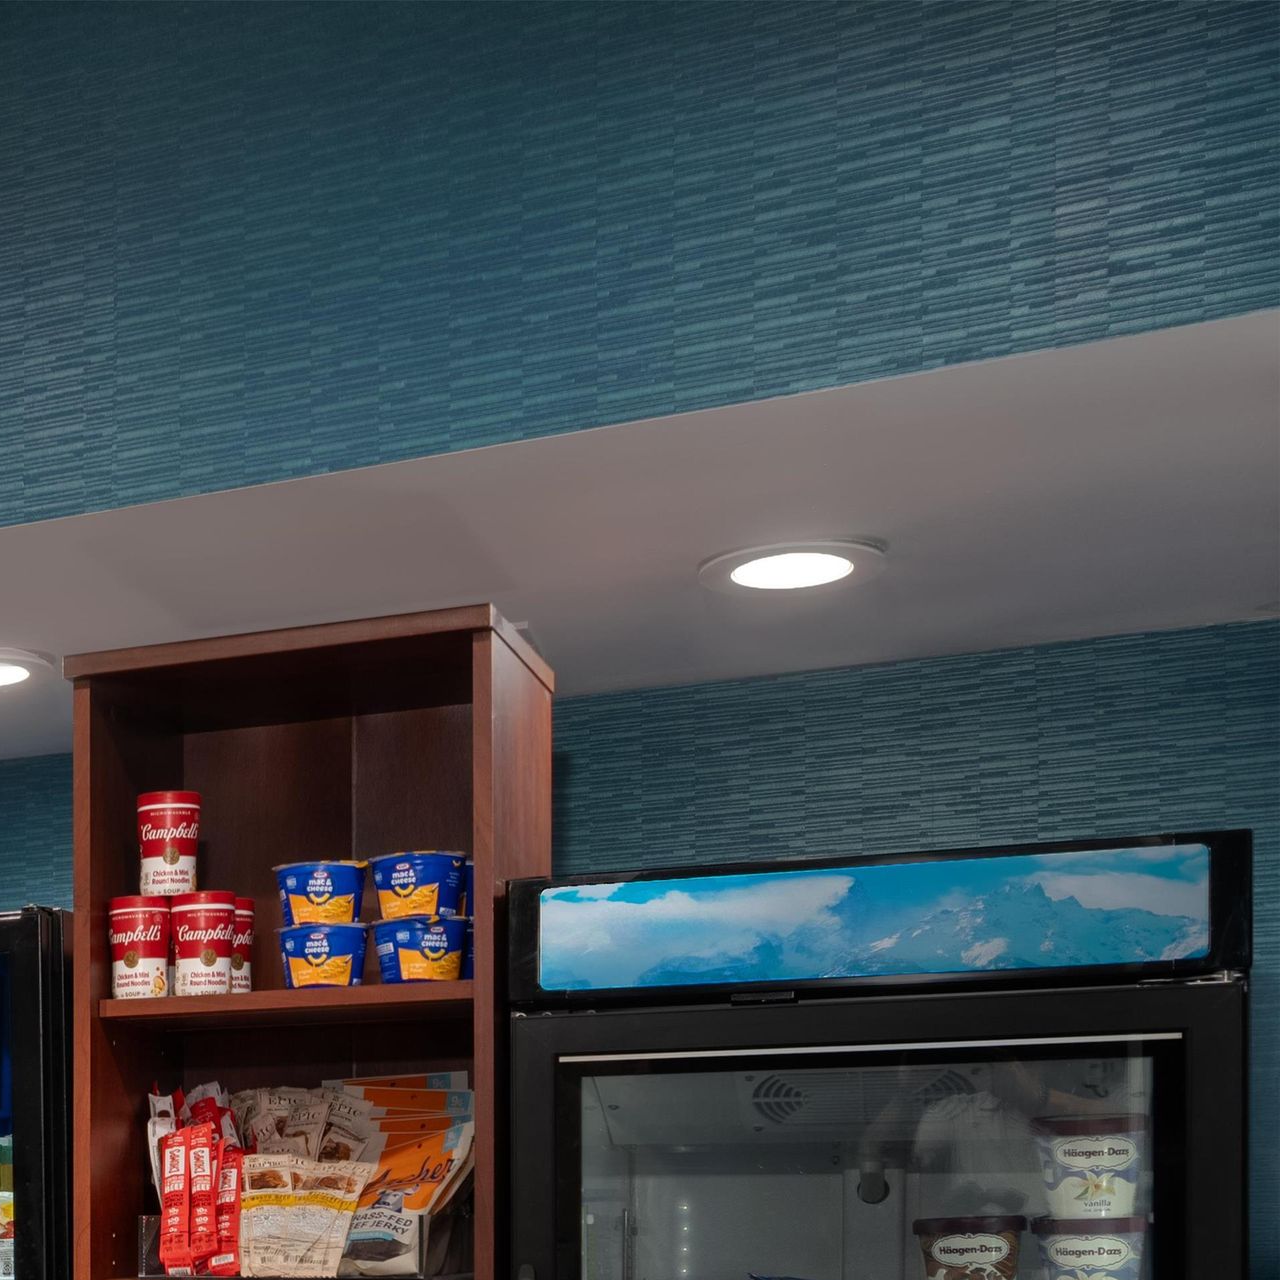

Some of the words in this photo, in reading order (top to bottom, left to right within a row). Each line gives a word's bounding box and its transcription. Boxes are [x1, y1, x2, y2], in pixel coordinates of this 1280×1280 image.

[141, 823, 199, 841] Campbell's
[152, 869, 173, 877] Chicken
[392, 871, 407, 879] mac
[117, 972, 134, 980] Chicken
[191, 971, 210, 979] Chicken
[1063, 1147, 1129, 1160] Häagen-Dazs
[1083, 1200, 1111, 1208] vanilla
[370, 1221, 409, 1235] JERKY
[939, 1244, 1002, 1255] Häagen-Dazs
[1055, 1246, 1122, 1257] Häagen-Dazs
